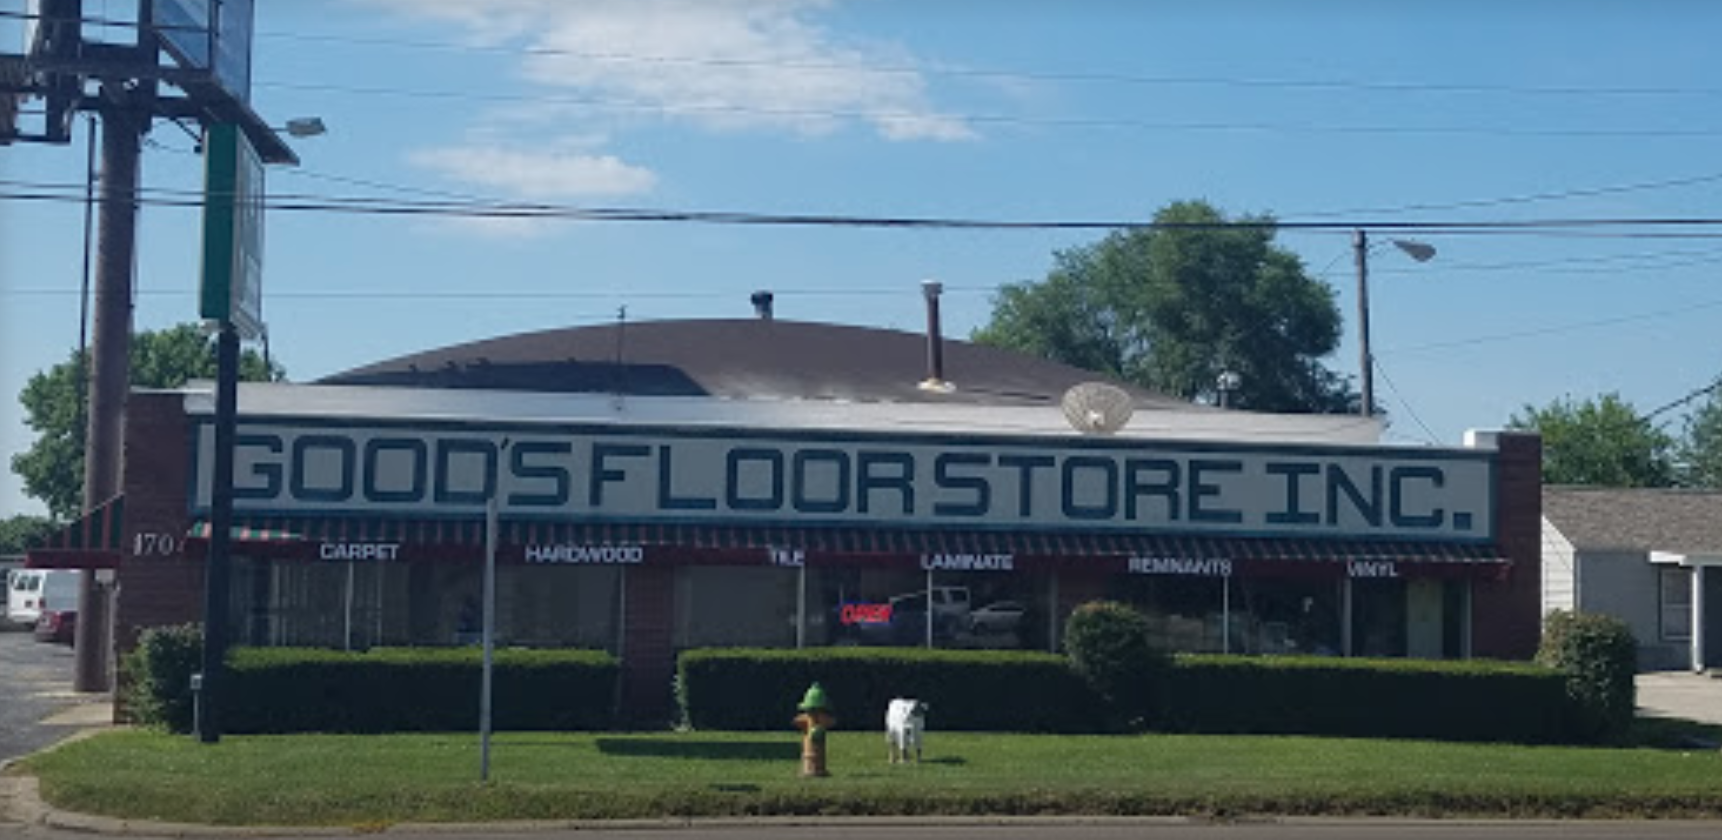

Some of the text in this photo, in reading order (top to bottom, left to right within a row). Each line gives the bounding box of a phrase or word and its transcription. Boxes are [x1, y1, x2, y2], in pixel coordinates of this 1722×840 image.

[224, 434, 1472, 531] GOOD'S FLOOR STORE INC.
[321, 543, 399, 560] CARPET
[525, 545, 643, 562] HARDWOOD
[921, 553, 1013, 570] LAMINATE
[1128, 557, 1232, 576] REMNANTS
[1346, 560, 1398, 577] VINYL
[840, 603, 892, 625] OPEN
